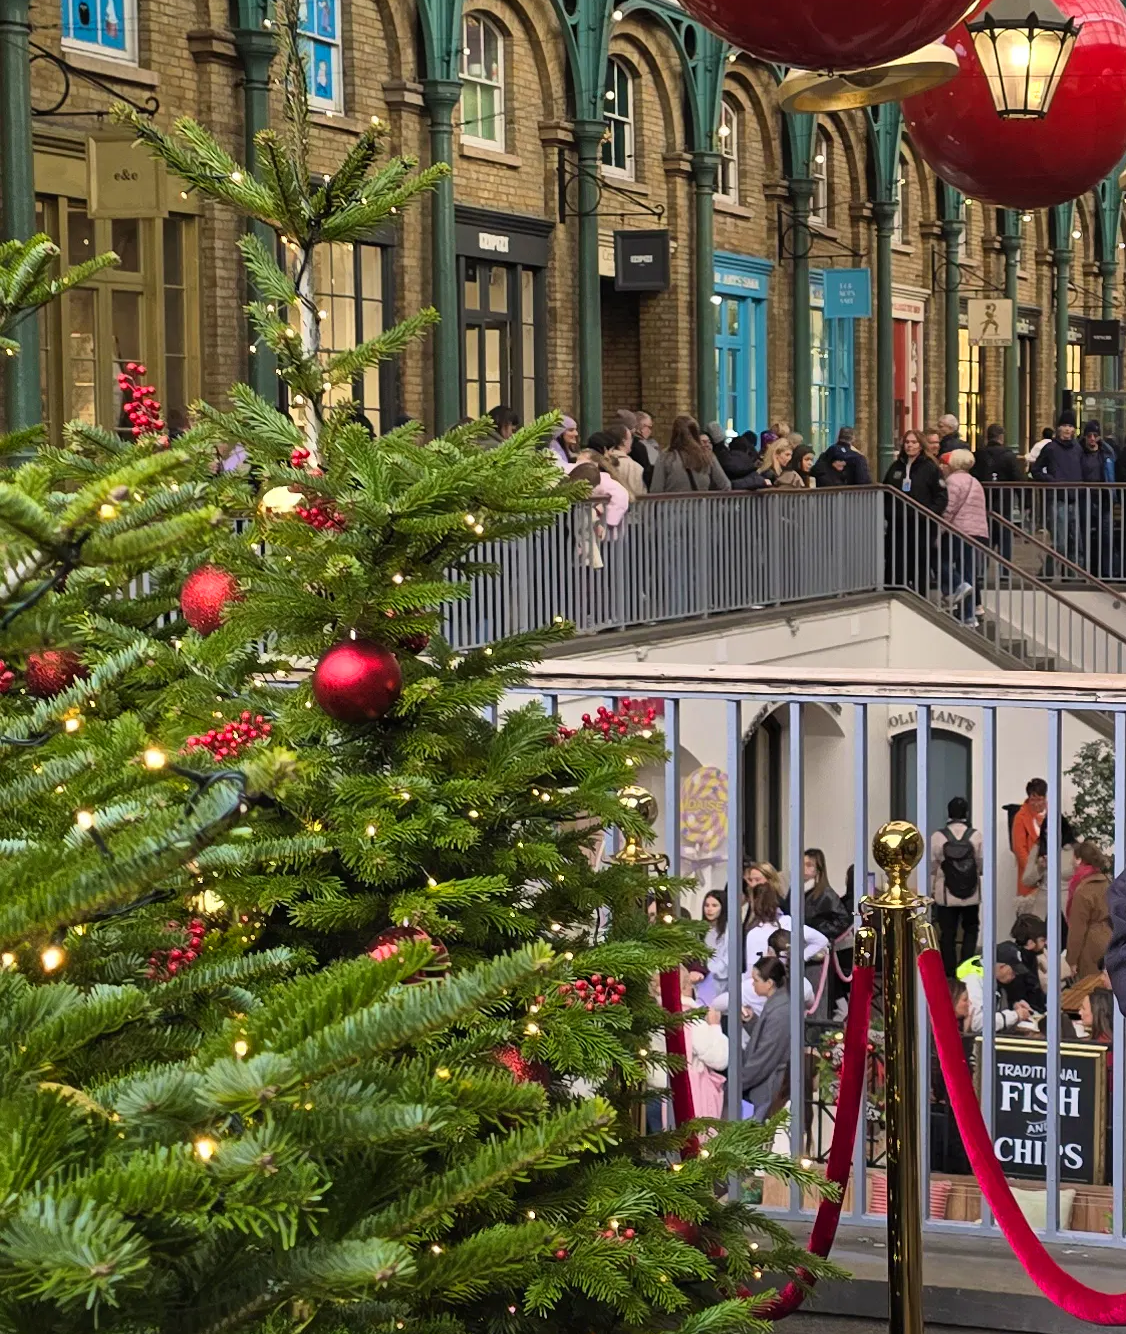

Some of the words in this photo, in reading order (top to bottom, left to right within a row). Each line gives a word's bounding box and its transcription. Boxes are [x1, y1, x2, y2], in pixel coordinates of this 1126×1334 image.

[888, 709, 976, 732] OLIANTS
[997, 1062, 1082, 1083] TRADITINAL
[1000, 1081, 1081, 1117] FISH
[993, 1136, 1084, 1170] CHIS
